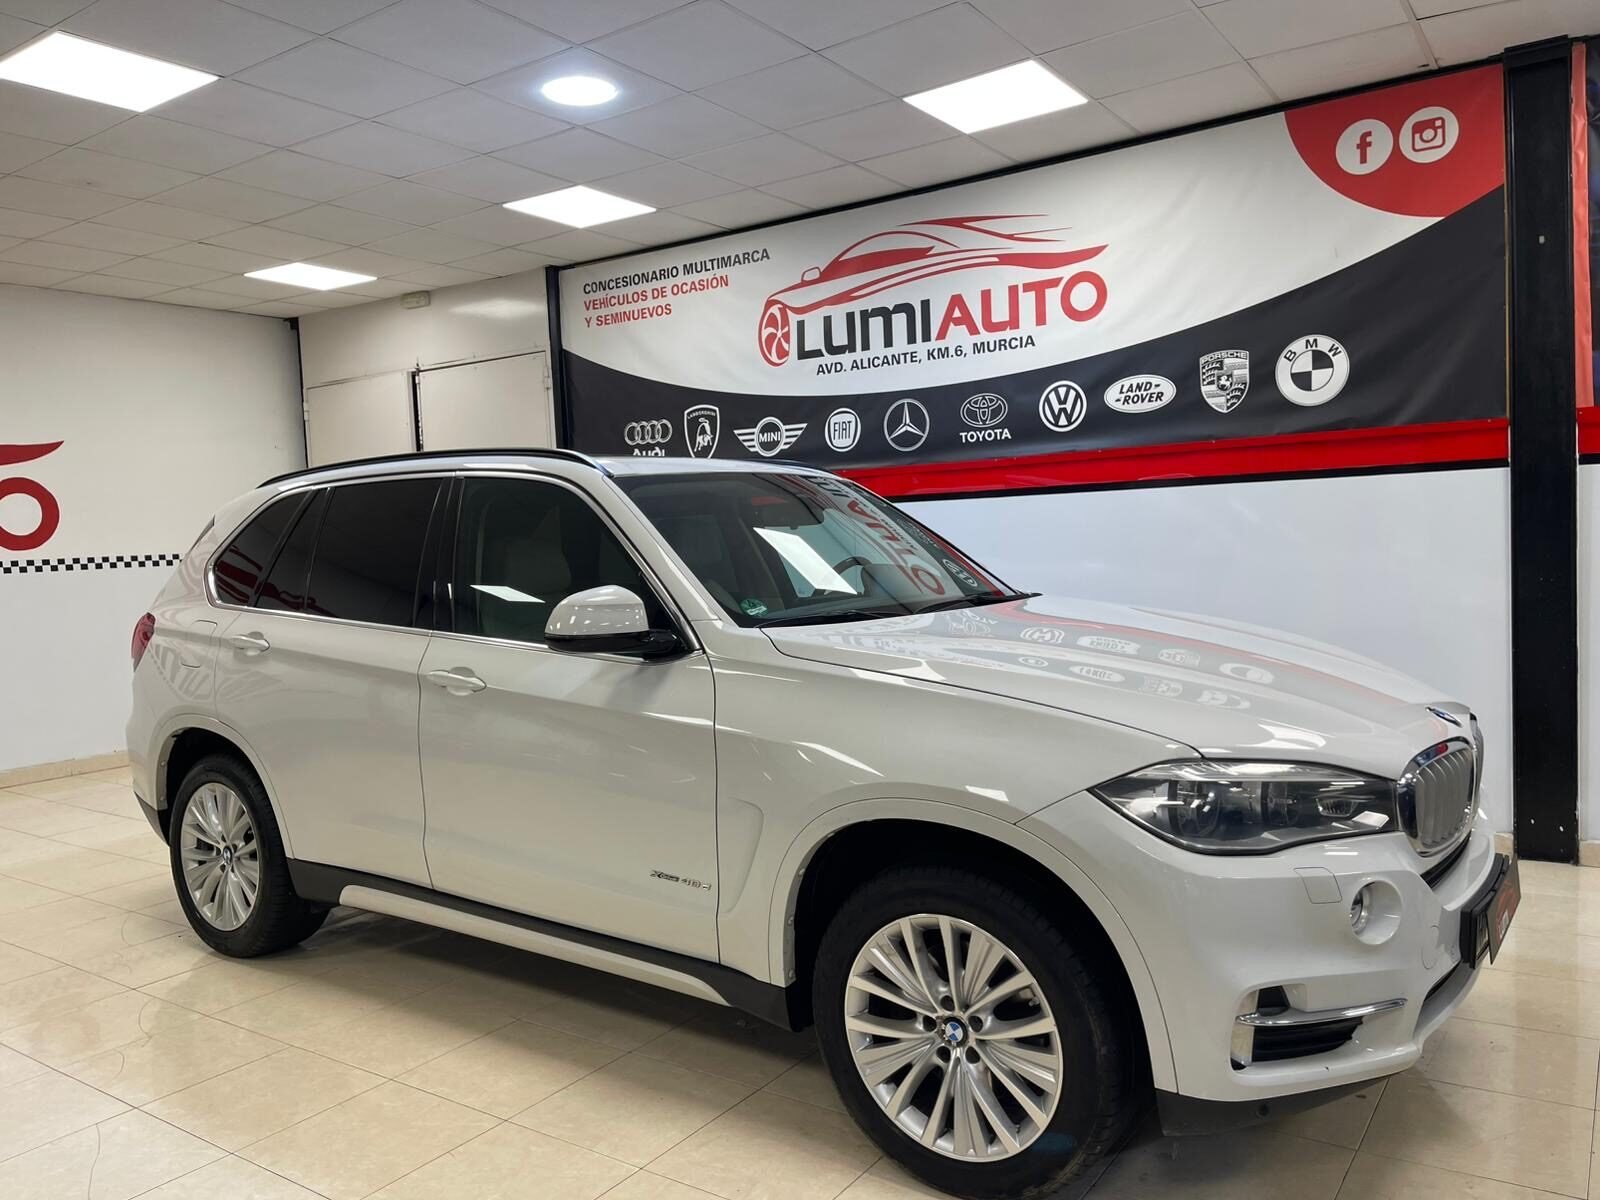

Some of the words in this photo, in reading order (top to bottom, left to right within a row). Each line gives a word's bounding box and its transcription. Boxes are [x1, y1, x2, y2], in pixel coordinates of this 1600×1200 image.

[583, 265, 679, 295] CONCESIONARIO
[683, 248, 771, 276] MULTIMARCA
[583, 290, 648, 311] VEHÍCULOS
[651, 286, 667, 299] DE
[671, 274, 729, 297] OCASIÓN
[585, 317, 592, 328] Y
[596, 303, 673, 327] SEMINUEVOS
[816, 361, 847, 376] AVD.
[850, 351, 922, 371] ALICANTE,
[926, 344, 968, 361] KM.6,
[972, 335, 1036, 355] MURCIA
[758, 430, 781, 443] MINI
[833, 420, 852, 441] FIAT
[959, 428, 1012, 443] TOYOTA
